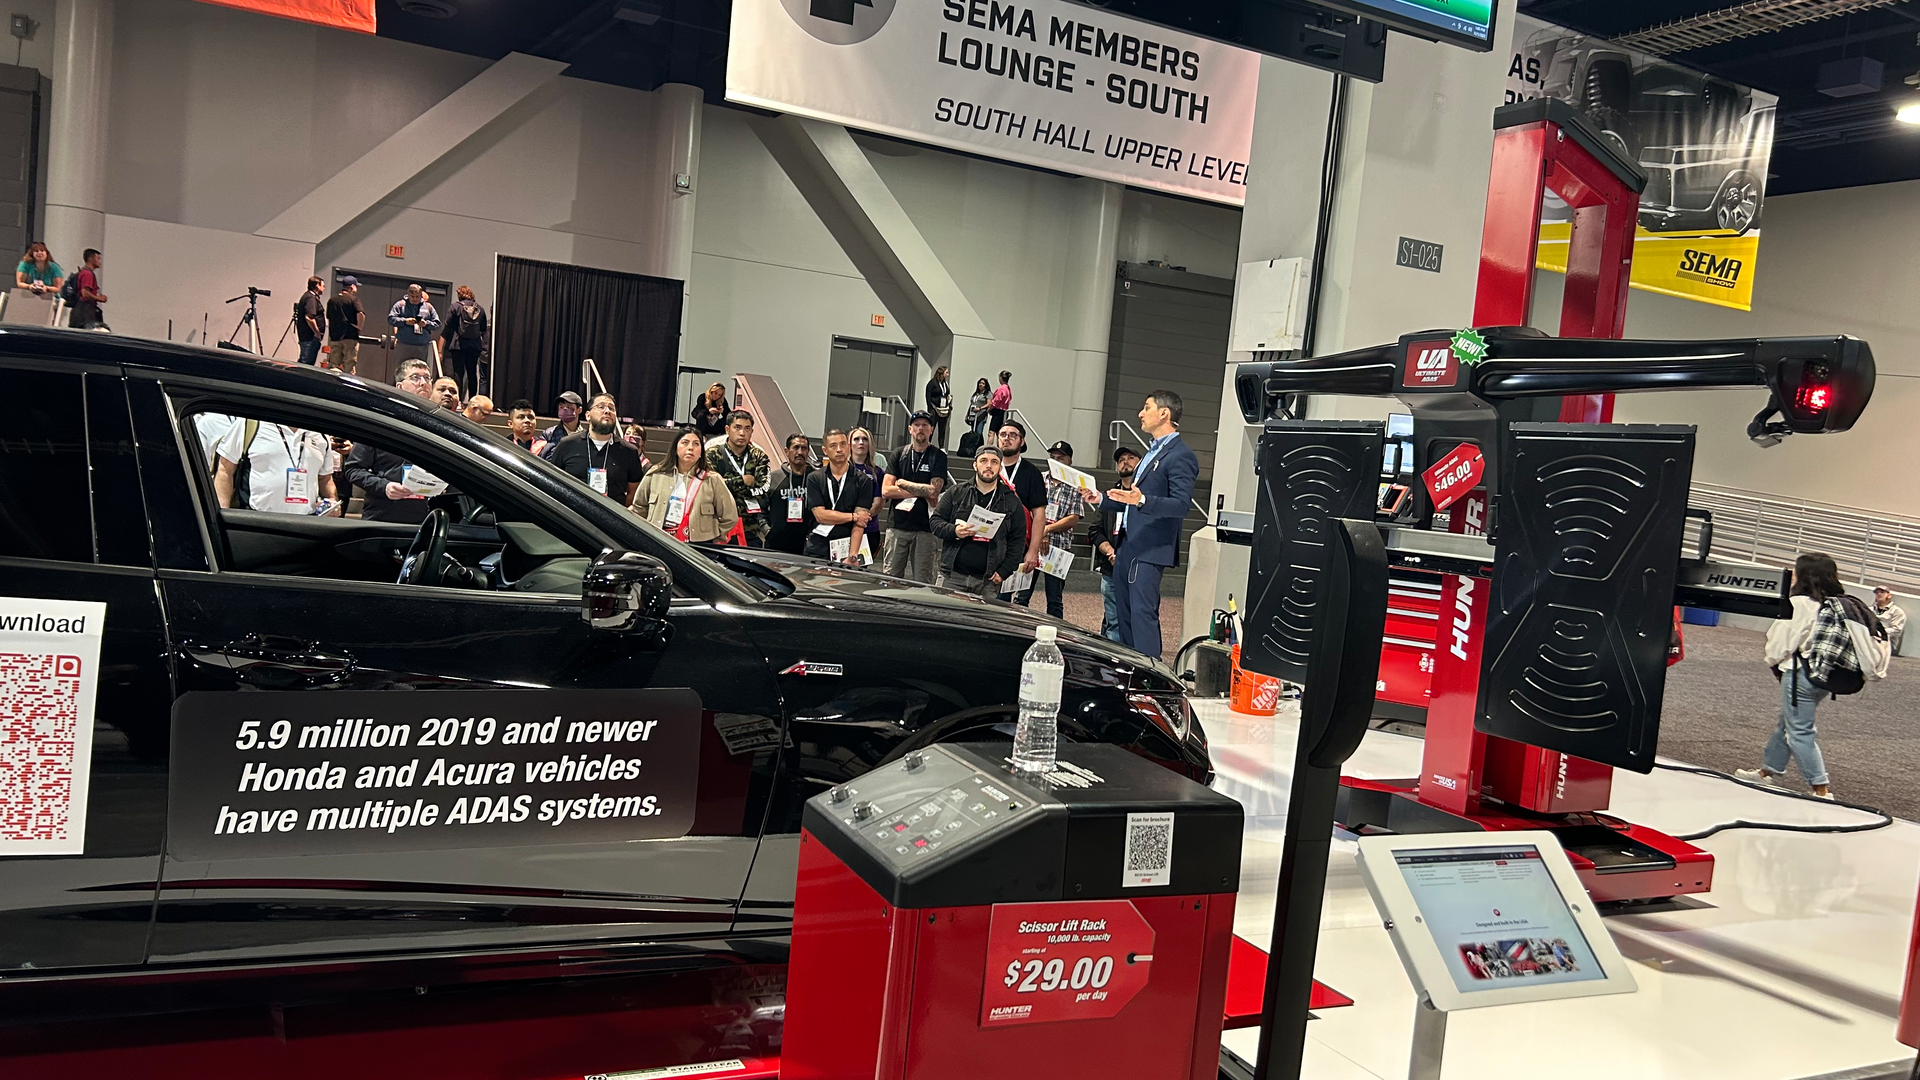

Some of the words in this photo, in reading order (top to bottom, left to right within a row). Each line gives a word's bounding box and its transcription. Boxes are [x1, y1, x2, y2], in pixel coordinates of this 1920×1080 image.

[943, 0, 1037, 42] SEMA
[1049, 16, 1200, 81] MEMBERS
[939, 31, 1076, 93] LOUNGE
[1106, 73, 1209, 124] SOUTH
[935, 97, 1027, 139] SOUTH
[1032, 119, 1095, 154] HALL
[1104, 134, 1183, 171] UPPER
[389, 244, 404, 257] EXIT
[1400, 240, 1440, 270] S1-025
[1679, 249, 1743, 281] SEMA
[1706, 278, 1735, 288] SHOW
[1455, 337, 1482, 357] NEW!
[1434, 460, 1471, 493] $46.00
[1707, 573, 1779, 591] HUNTER
[235, 720, 292, 750] 5.9
[297, 718, 411, 749] million
[417, 717, 497, 746] 2019
[502, 716, 562, 745] and
[565, 719, 658, 743] newer
[238, 761, 347, 792] Honda
[355, 759, 419, 789] and
[422, 758, 516, 786] Acura
[525, 754, 642, 783] vehicles
[214, 805, 299, 835] have
[306, 799, 440, 834] multiple
[444, 794, 532, 825] ADAS
[537, 793, 662, 827] systems.
[1018, 920, 1060, 934] Scissor
[1060, 919, 1079, 932] Lift
[1080, 918, 1107, 931] Rack
[1047, 934, 1071, 944] 10,000
[1071, 934, 1080, 942] lb.
[1082, 933, 1112, 943] capacity
[1004, 956, 1114, 994] $29.00
[990, 1005, 1032, 1015] HUNTER
[1076, 992, 1092, 1003] per
[1092, 990, 1108, 1001] day
